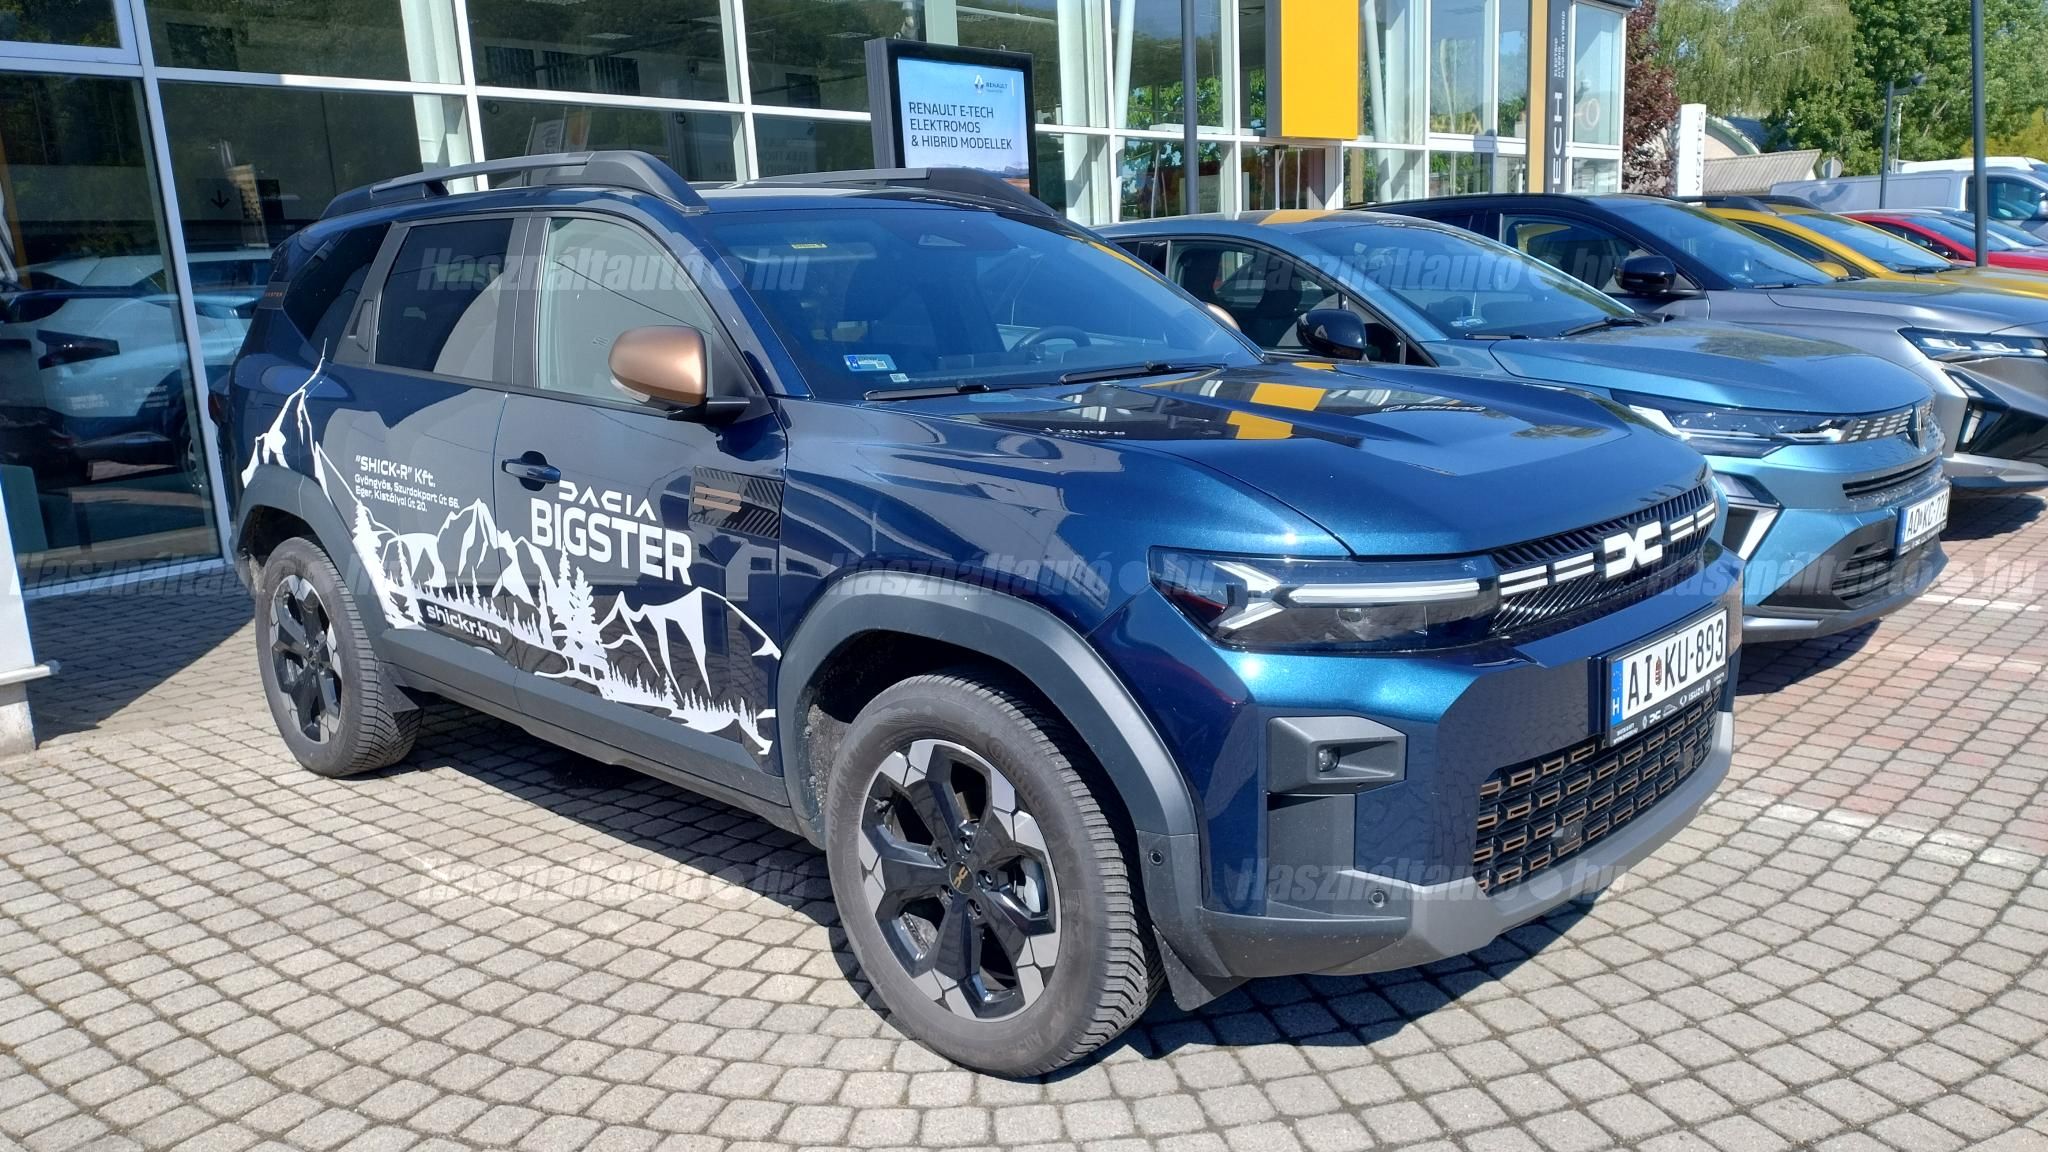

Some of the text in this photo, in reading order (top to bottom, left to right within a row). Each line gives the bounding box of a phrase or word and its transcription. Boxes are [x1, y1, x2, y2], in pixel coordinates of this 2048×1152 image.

[909, 102, 994, 118] RENAULT E-TECH
[910, 119, 981, 133] ELEKTROMOS
[911, 135, 1013, 150] & HIBRID MODELLEK
[414, 467, 436, 488] Kft.
[559, 480, 656, 521] DACIA
[531, 498, 692, 586] BIGSTER
[426, 605, 502, 645] shickr.hu
[1612, 697, 1620, 716] H
[1627, 654, 1652, 711] AI
[1688, 685, 1705, 700] ISUZU
